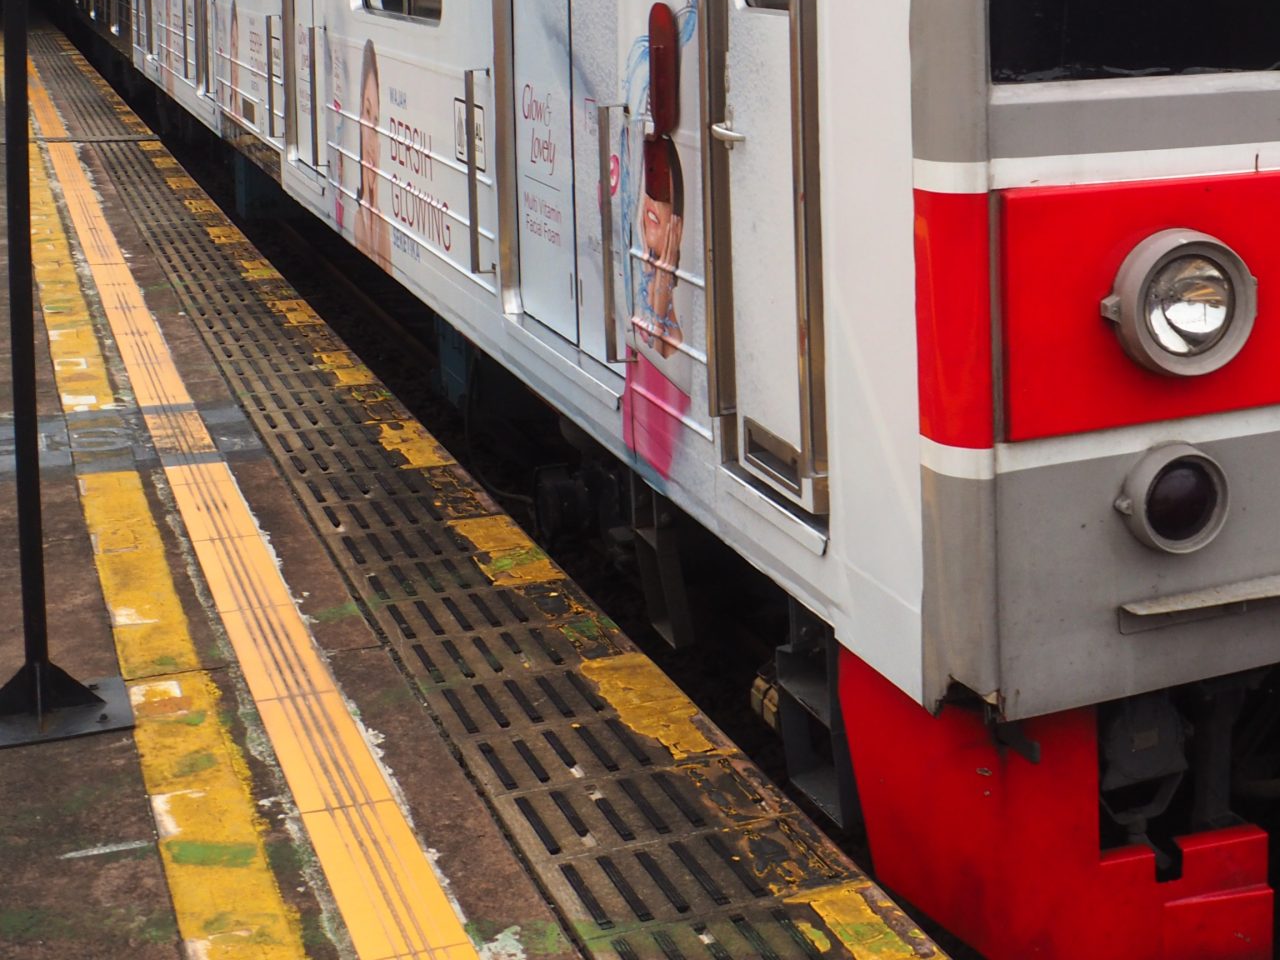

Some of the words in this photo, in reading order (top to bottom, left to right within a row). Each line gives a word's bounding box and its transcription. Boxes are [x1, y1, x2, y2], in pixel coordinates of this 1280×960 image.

[390, 117, 433, 182] BERSIH
[530, 128, 556, 176] Lovely
[391, 173, 452, 253] GLOWING
